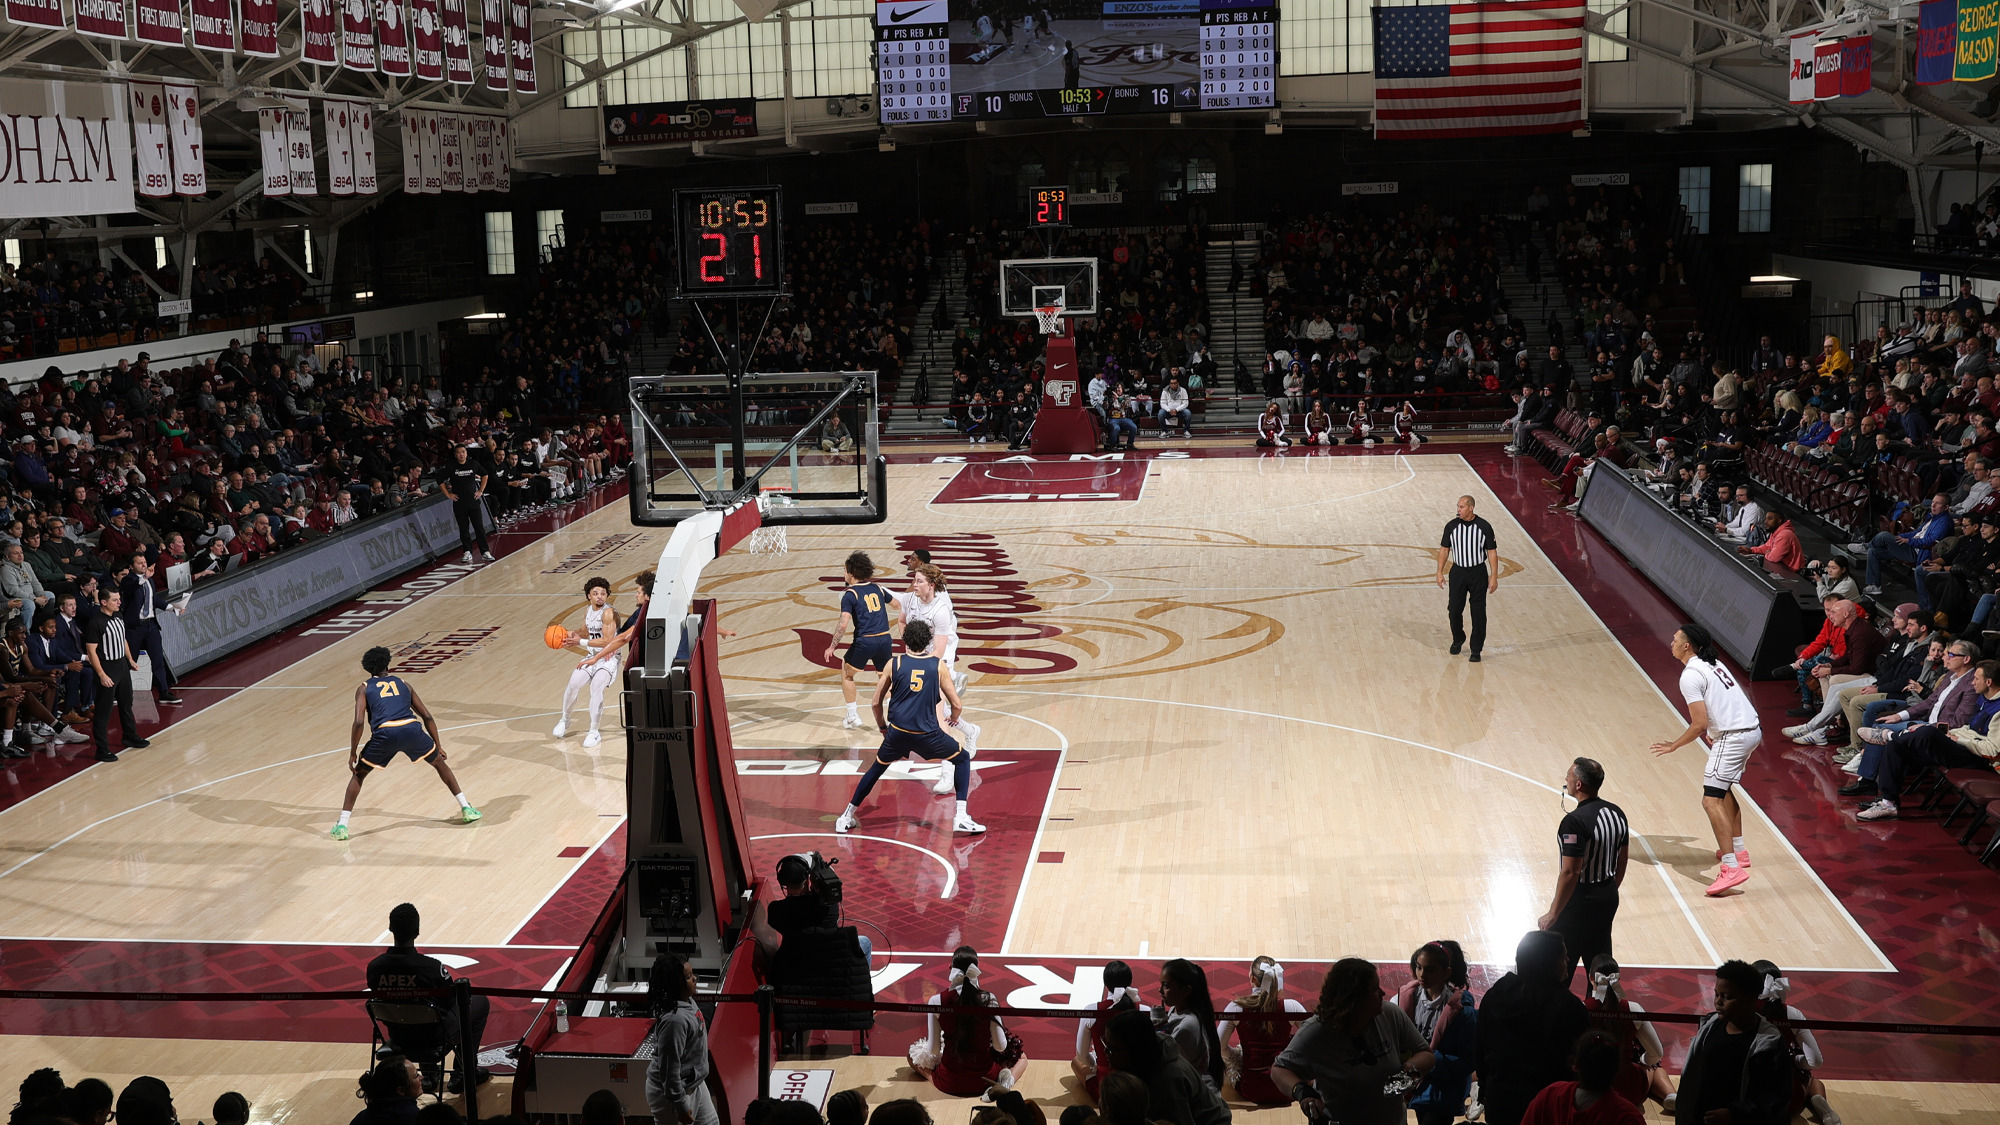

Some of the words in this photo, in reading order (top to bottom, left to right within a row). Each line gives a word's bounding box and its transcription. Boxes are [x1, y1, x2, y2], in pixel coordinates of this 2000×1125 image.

[78, 0, 123, 22] CHAMPIONS
[1114, 3, 1154, 12] ENZO'S
[140, 6, 157, 25] FIRST
[159, 10, 181, 29] ROUND
[1216, 13, 1230, 22] PTS
[1234, 12, 1248, 22] REB
[1252, 12, 1258, 21] A
[1264, 11, 1268, 20] F
[1960, 1, 1998, 32] GEORGE
[271, 22, 277, 38] 3
[894, 29, 907, 38] PTS
[910, 28, 924, 38] REB
[928, 28, 933, 37] A
[939, 28, 943, 36] F
[1206, 28, 1210, 37] 1
[1220, 27, 1225, 36] 2
[1238, 26, 1243, 36] 0
[1253, 25, 1258, 35] 0
[1264, 25, 1268, 34] 0
[884, 43, 889, 53] 3
[898, 43, 903, 52] 0
[915, 42, 920, 51] 0
[929, 41, 934, 51] 0
[939, 40, 944, 50] 0
[1206, 41, 1210, 50] 5
[1220, 40, 1226, 50] 0
[1238, 39, 1243, 49] 3
[1253, 39, 1258, 48] 0
[1264, 38, 1268, 48] 0
[1959, 36, 1996, 64] MASON
[884, 56, 889, 65] 4
[899, 56, 904, 65] 0
[916, 55, 921, 64] 0
[929, 54, 934, 64] 0
[940, 54, 944, 63] 0
[1204, 55, 1213, 65] 10
[1220, 54, 1225, 64] 0
[1239, 53, 1244, 63] 0
[1254, 53, 1258, 62] 1
[1264, 52, 1268, 62] 0
[1815, 51, 1842, 74] DAVIDSON
[883, 70, 892, 79] 10
[900, 69, 904, 78] 0
[916, 68, 921, 78] 0
[930, 68, 934, 77] 0
[940, 67, 945, 77] 0
[1204, 69, 1213, 79] 15
[1220, 69, 1226, 78] 6
[1239, 68, 1244, 78] 2
[1253, 67, 1258, 77] 0
[1264, 67, 1268, 76] 0
[1791, 59, 1813, 80] A10
[884, 84, 893, 94] 13
[900, 83, 905, 93] 0
[916, 83, 921, 92] 0
[930, 82, 935, 92] 0
[940, 82, 945, 91] 0
[1115, 88, 1139, 98] BONUS
[1204, 84, 1213, 93] 21
[1221, 83, 1226, 92] 0
[1239, 82, 1244, 92] 2
[1253, 81, 1258, 91] 0
[1264, 81, 1268, 90] 0
[884, 98, 893, 107] 30
[900, 97, 905, 106] 0
[917, 96, 922, 106] 0
[930, 96, 935, 105] 0
[941, 95, 946, 105] 0
[1009, 92, 1033, 102] BONUS
[1058, 89, 1091, 104] 10:53
[1152, 88, 1168, 105] 16
[1208, 98, 1230, 107] FOULS:
[1248, 96, 1262, 105] TOL:
[1265, 96, 1270, 104] 4
[985, 96, 1001, 112] 10
[1063, 104, 1078, 112] HALF
[1086, 103, 1090, 112] 1
[887, 112, 910, 120] FOULS:
[914, 111, 918, 119] 0
[927, 110, 941, 119] TOL:
[943, 110, 947, 118] 3
[618, 132, 689, 142] CELEBRATING
[694, 130, 706, 138] 50
[712, 128, 745, 137] YEARS
[268, 175, 288, 188] 1983
[1608, 175, 1626, 184] 120
[1377, 183, 1395, 192] 119
[1038, 191, 1064, 202] 10:53
[632, 211, 649, 219] 116
[700, 199, 767, 228] 10:53
[1038, 203, 1062, 222] 21
[700, 233, 762, 283] 21
[179, 301, 189, 312] 114
[360, 522, 424, 571] ENZO'S
[864, 593, 881, 613] 10
[179, 587, 267, 650] ENZO'S
[298, 609, 393, 637] THE
[386, 649, 464, 674] ROSE
[431, 626, 501, 647] HILL
[910, 670, 925, 692] 5
[1714, 668, 1735, 690] 13
[376, 681, 400, 698] 21
[637, 731, 682, 742] SPALDING
[378, 975, 417, 987] APEX
